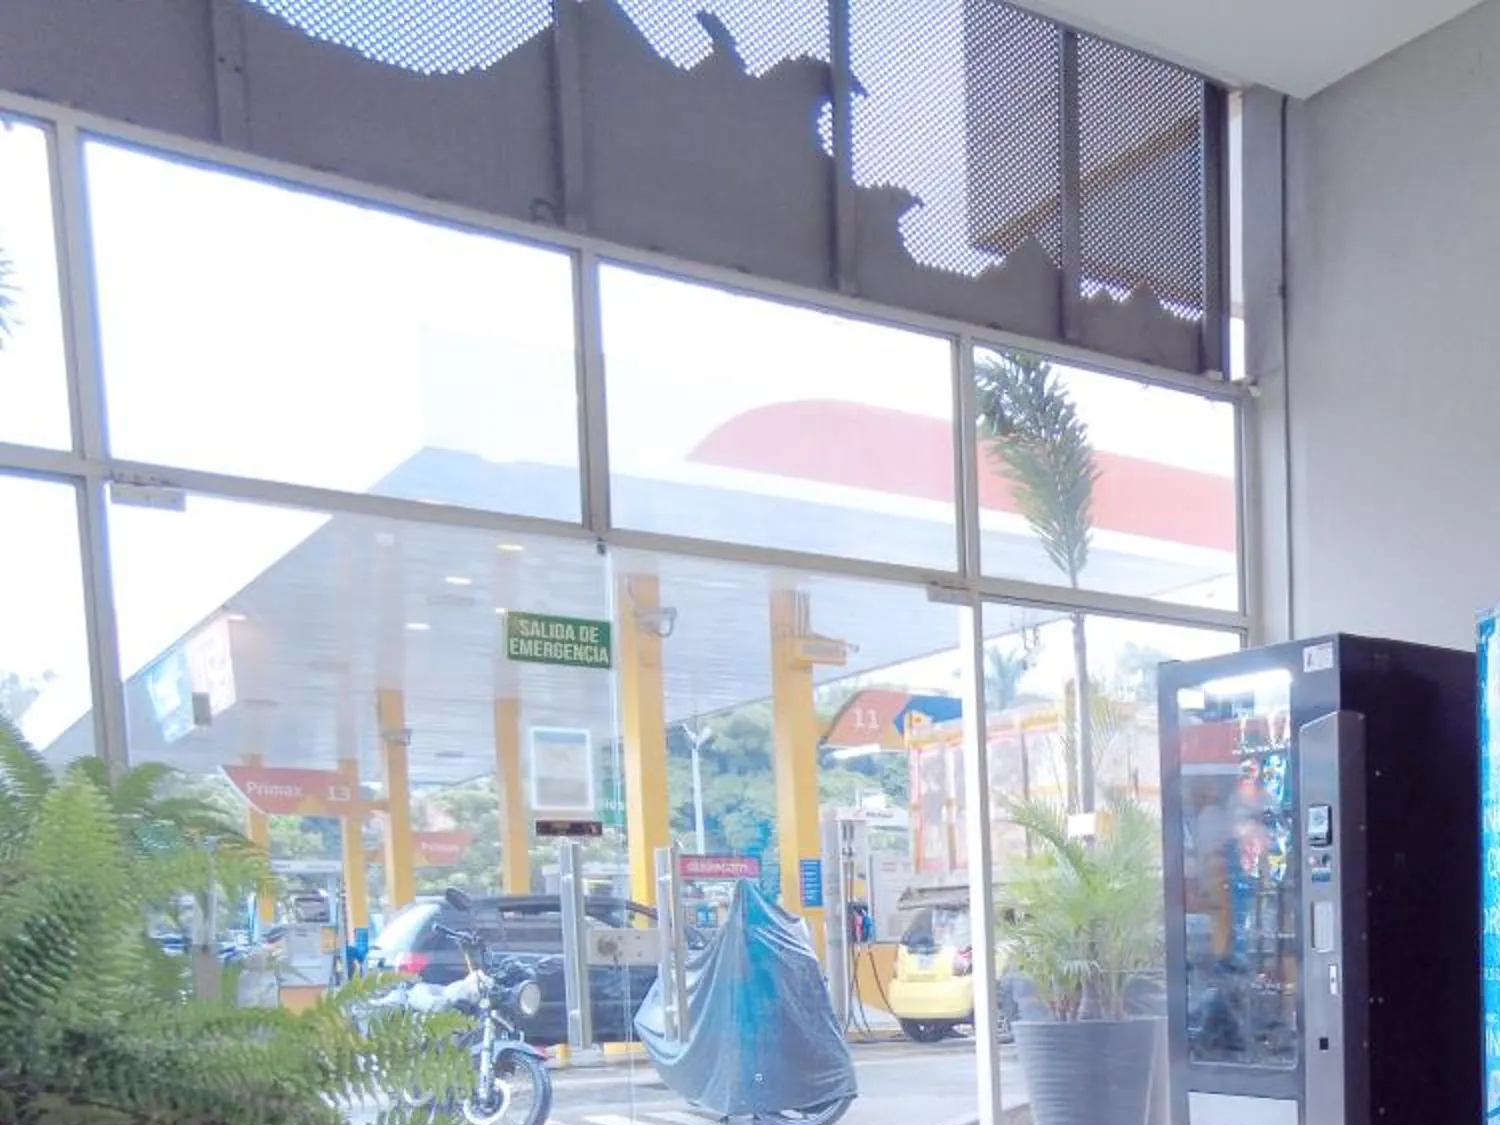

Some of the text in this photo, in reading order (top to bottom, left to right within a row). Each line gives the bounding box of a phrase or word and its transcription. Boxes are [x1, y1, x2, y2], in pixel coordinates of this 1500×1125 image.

[519, 619, 599, 643] SALIDA DE
[509, 637, 609, 664] EMERGENCIA
[247, 782, 351, 800] Primax 13
